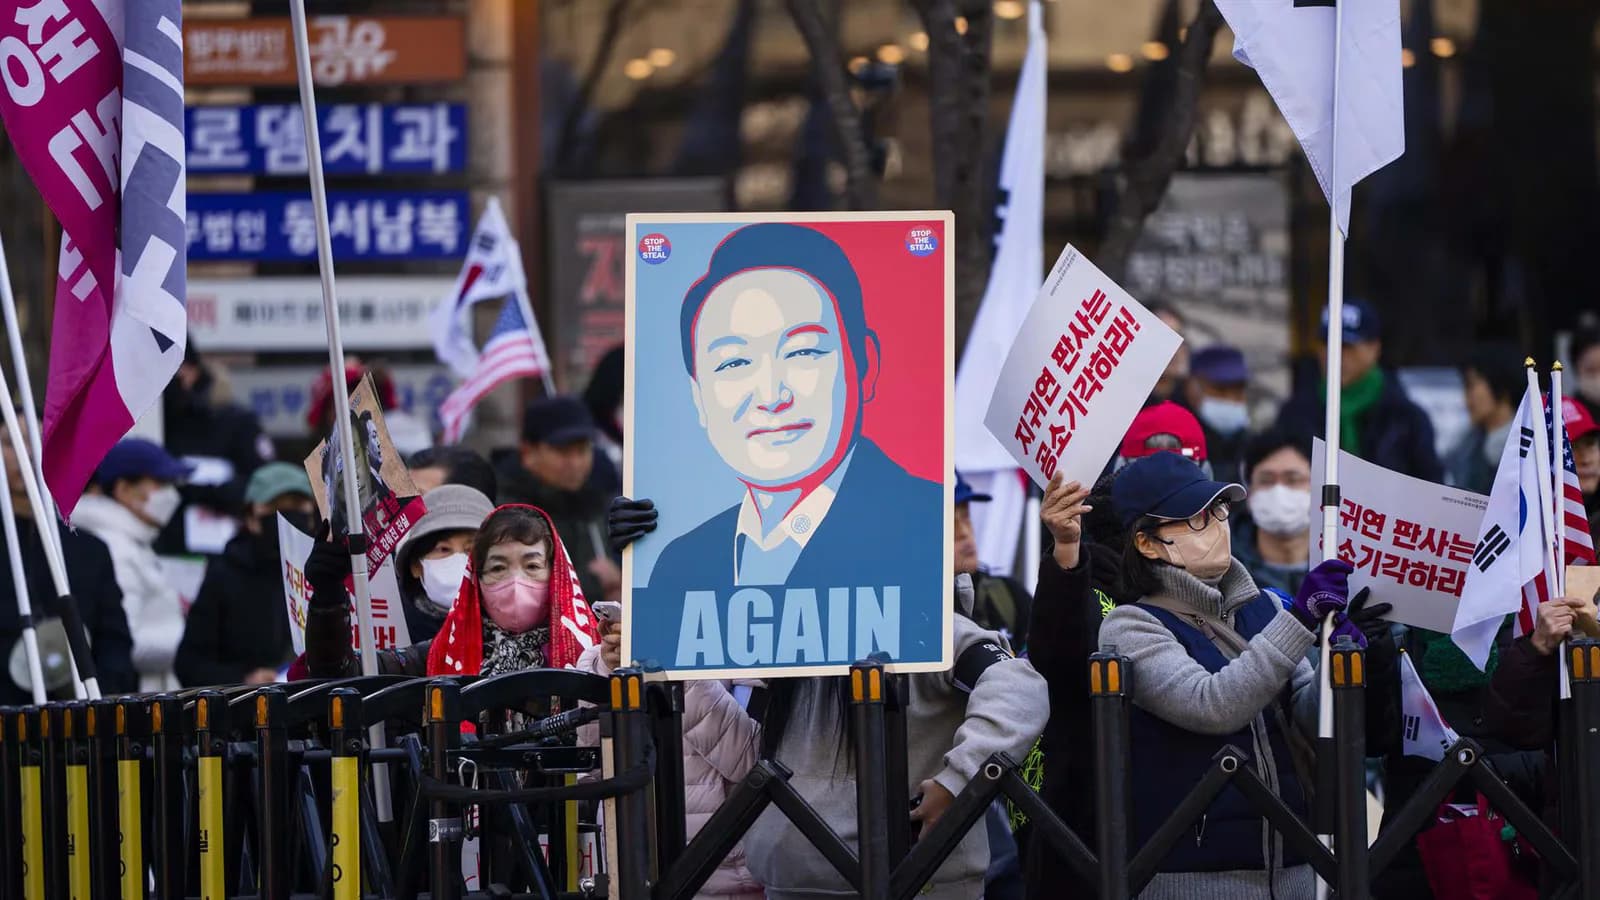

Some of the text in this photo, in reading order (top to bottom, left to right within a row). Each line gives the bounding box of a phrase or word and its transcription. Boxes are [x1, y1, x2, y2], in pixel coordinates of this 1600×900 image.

[310, 15, 397, 87] 공유
[282, 200, 461, 255] 동서남북
[642, 251, 667, 259] STEAL
[910, 243, 934, 251] STEAL
[911, 229, 932, 237] STOP
[1014, 366, 1062, 455] 지귀연
[1051, 288, 1112, 375] 판사는
[1035, 305, 1141, 481] 공소기각하라!
[1319, 497, 1478, 566] 귀연 판사는
[1319, 533, 1467, 598] 소기각하라
[675, 585, 901, 667] AGAIN
